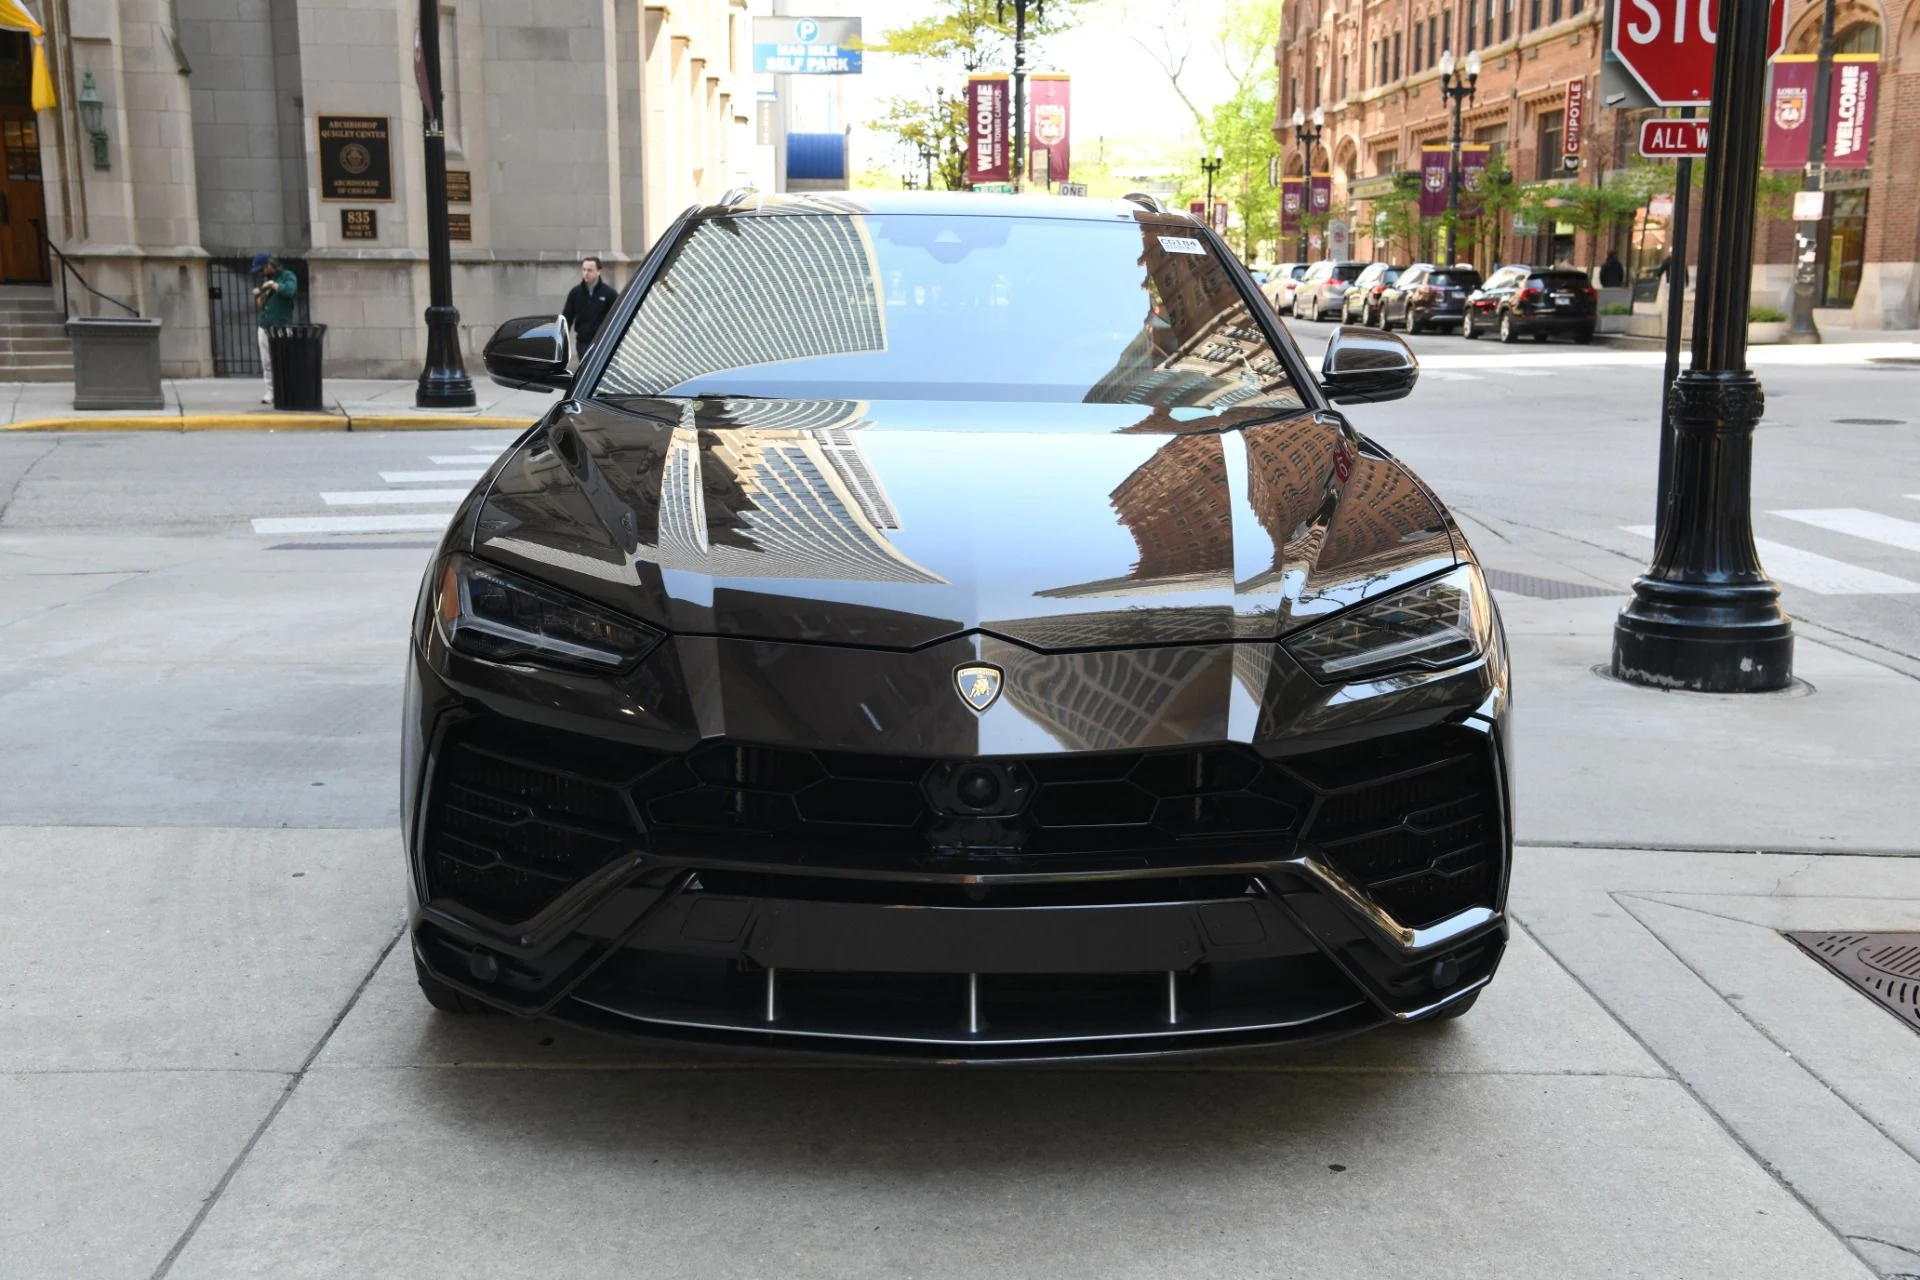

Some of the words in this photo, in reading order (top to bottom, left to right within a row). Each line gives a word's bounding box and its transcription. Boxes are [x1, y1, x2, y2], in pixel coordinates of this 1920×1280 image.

[1627, 0, 1717, 44] ST
[807, 58, 849, 72] PARK
[994, 89, 1002, 117] CAMPUS
[1834, 65, 1860, 157] WELCOME
[977, 84, 993, 172] WELCOME
[1567, 82, 1583, 152] CHIPOTLE
[355, 129, 386, 138] CENTER
[994, 119, 1002, 143] TOWER
[1651, 128, 1687, 149] ALL
[994, 144, 1002, 167] WATER
[1061, 186, 1084, 196] ONE
[347, 211, 370, 224] 835
